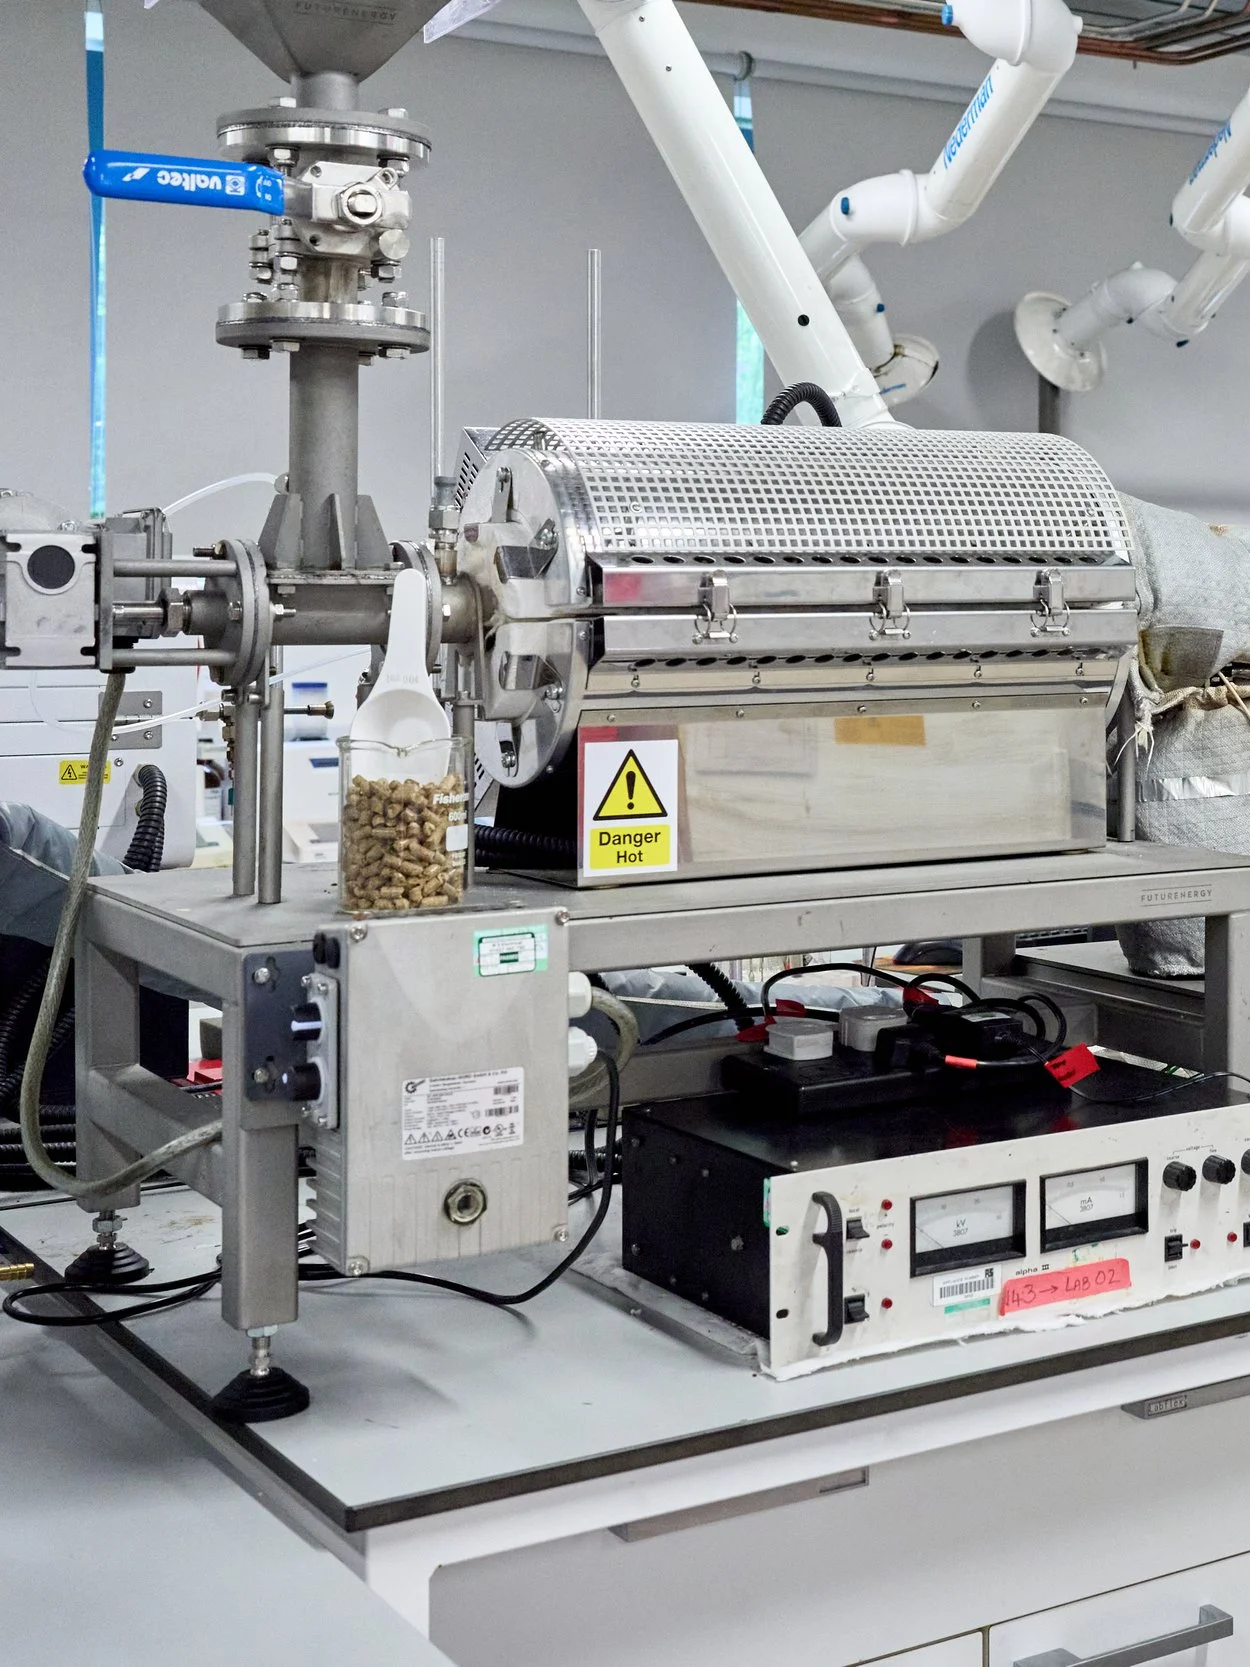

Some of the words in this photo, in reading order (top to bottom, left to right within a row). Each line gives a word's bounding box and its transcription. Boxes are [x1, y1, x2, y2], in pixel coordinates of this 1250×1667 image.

[156, 170, 222, 192] valtec
[598, 831, 661, 848] Danger
[616, 850, 643, 864] Hot
[1140, 889, 1212, 903] FUTURENERGY
[1080, 1196, 1093, 1206] mA
[955, 1218, 967, 1229] kV
[1015, 1266, 1038, 1276] alpha
[1065, 1276, 1091, 1292] LAB
[1094, 1268, 1121, 1286] 02
